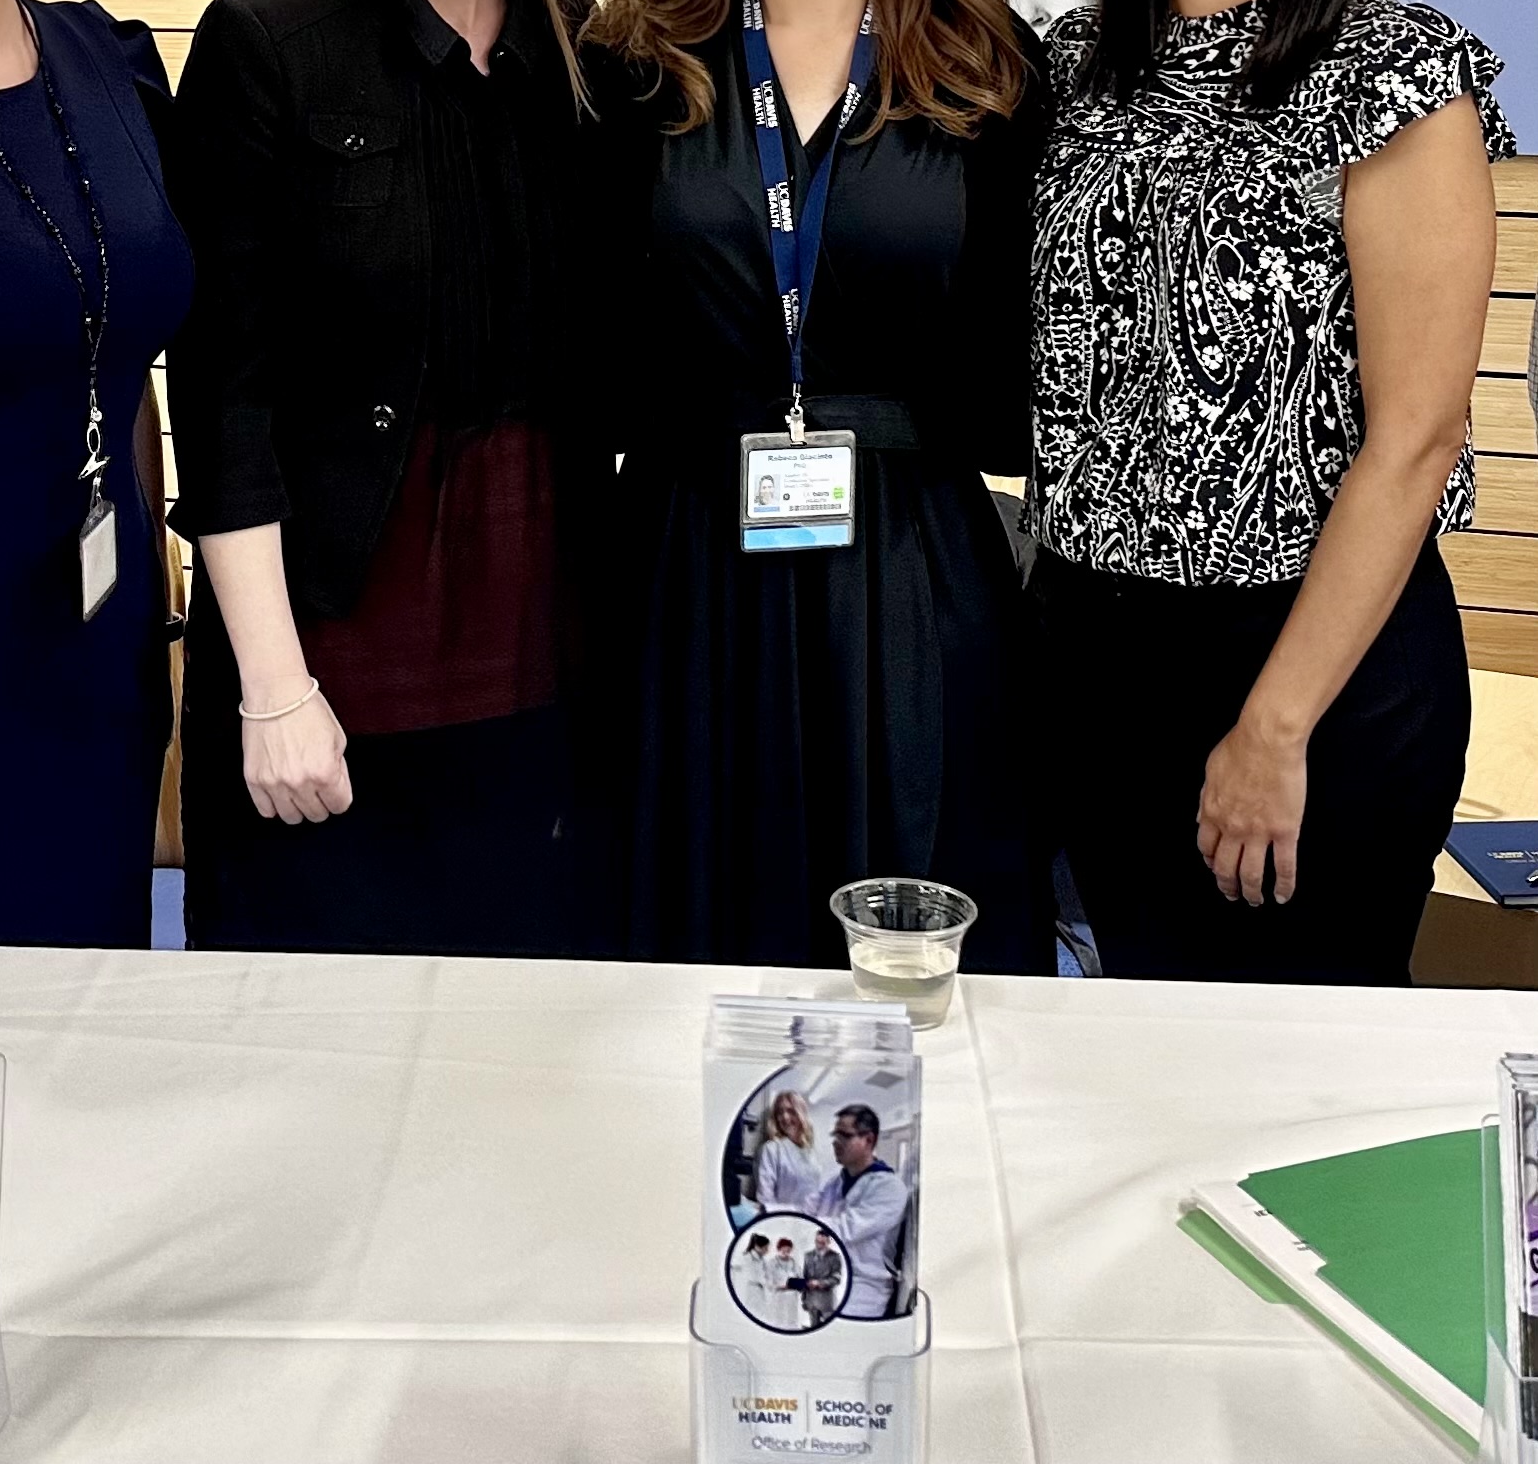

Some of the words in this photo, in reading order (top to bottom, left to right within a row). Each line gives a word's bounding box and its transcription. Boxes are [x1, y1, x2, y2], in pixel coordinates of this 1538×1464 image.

[752, 88, 765, 124] HEALTH
[767, 188, 780, 228] HEALTH
[739, 1413, 792, 1424] HEALTH
[875, 1404, 893, 1415] OF
